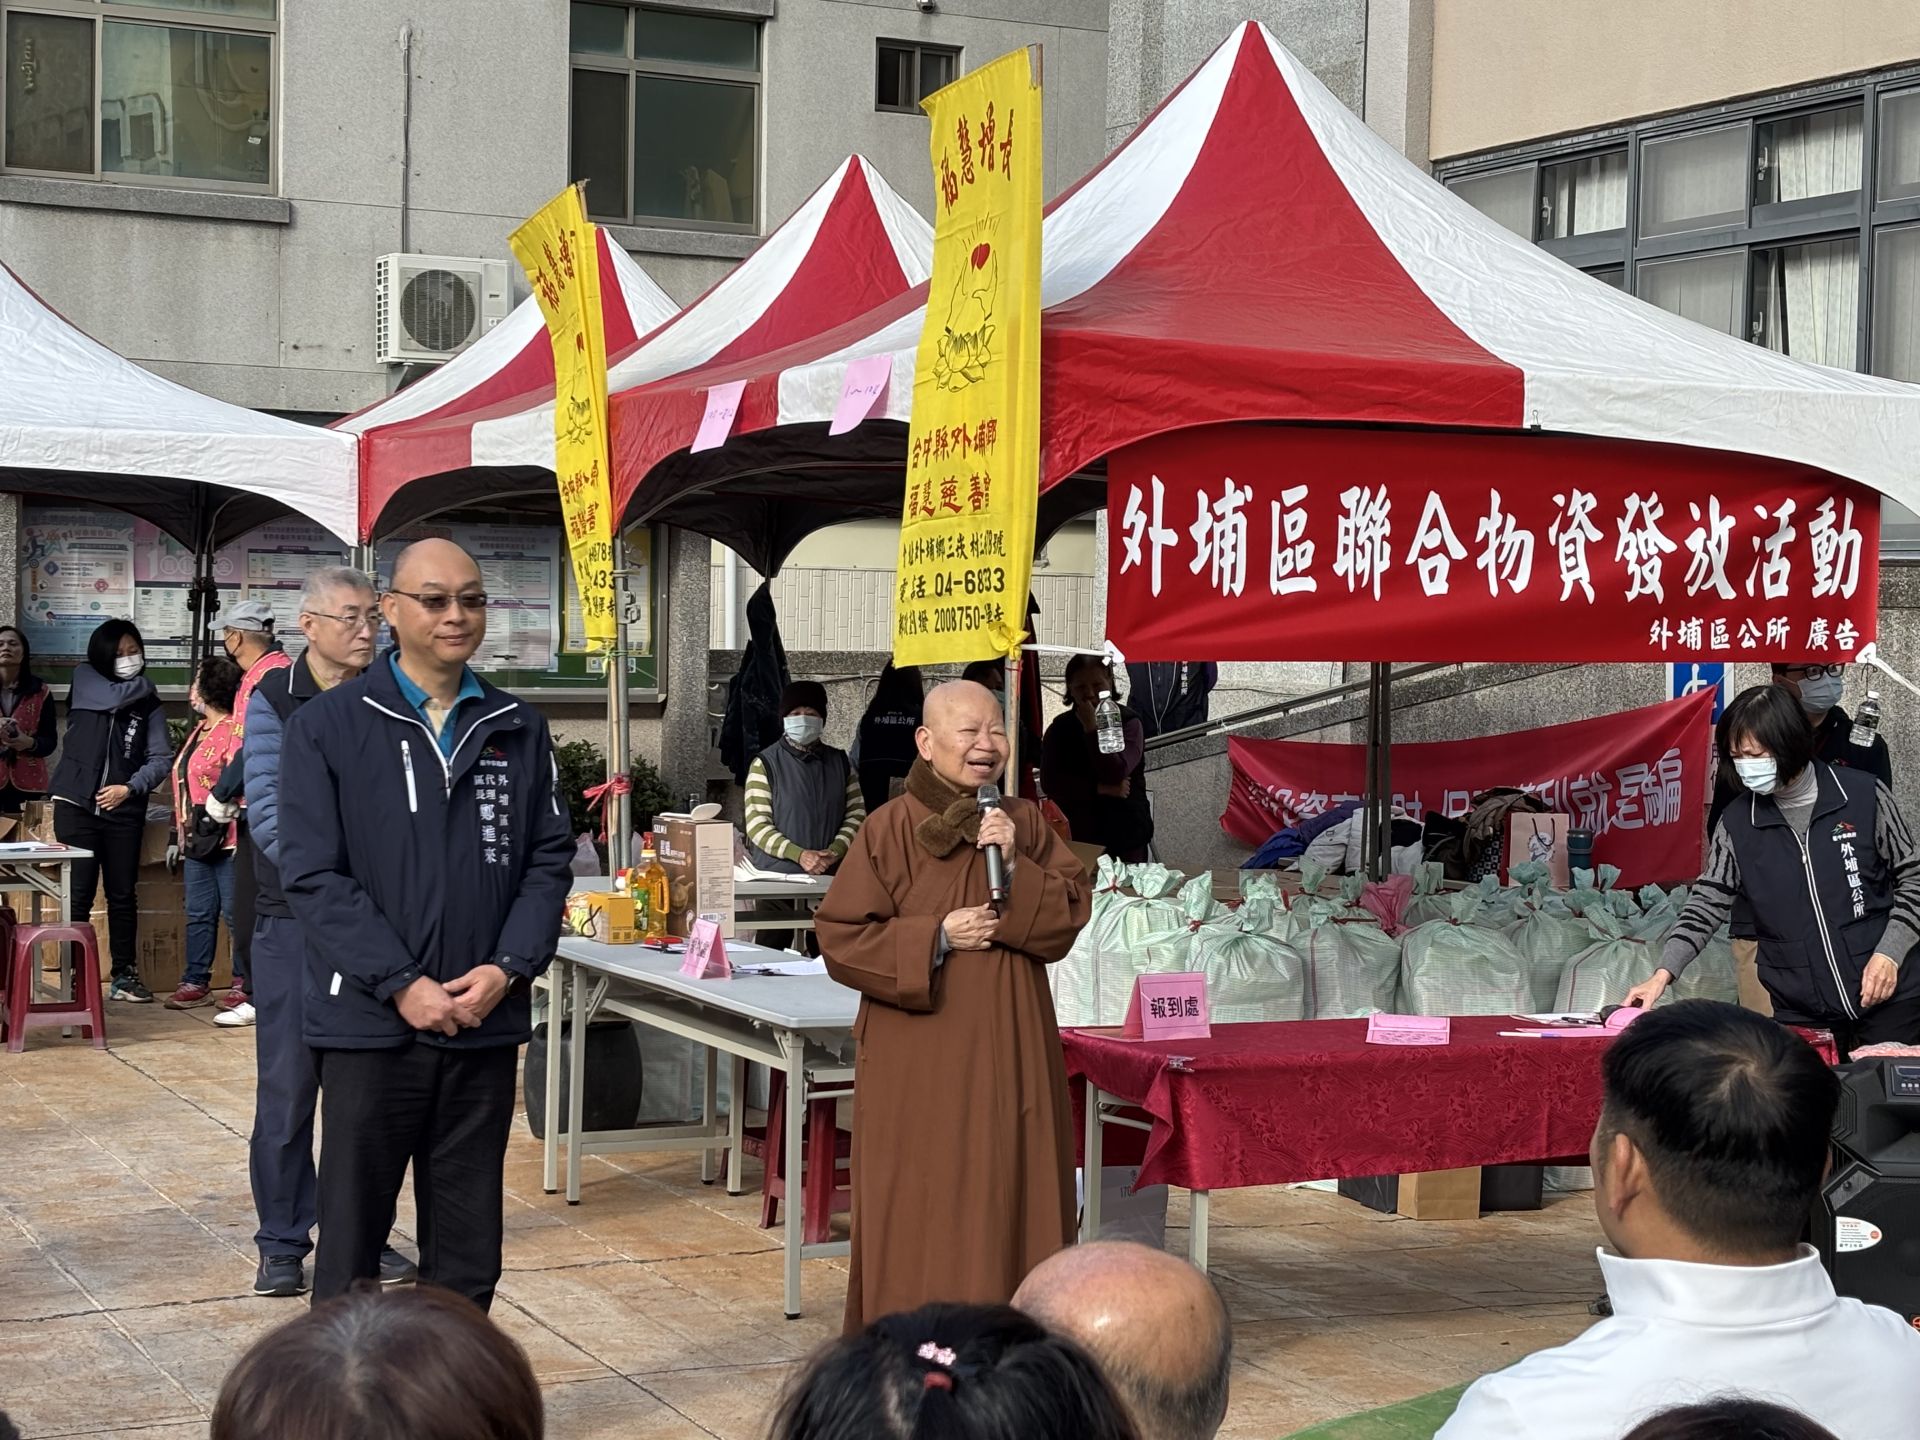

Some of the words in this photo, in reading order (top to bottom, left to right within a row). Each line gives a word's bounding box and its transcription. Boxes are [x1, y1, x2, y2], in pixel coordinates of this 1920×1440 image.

[1120, 474, 1863, 604] 外埔區聯合物資發放活動
[1650, 617, 1790, 650] 外埔區公所
[1805, 618, 1860, 650] 廣告
[1840, 842, 1864, 918] 外埔區公所
[1151, 996, 1200, 1018] 報到處
